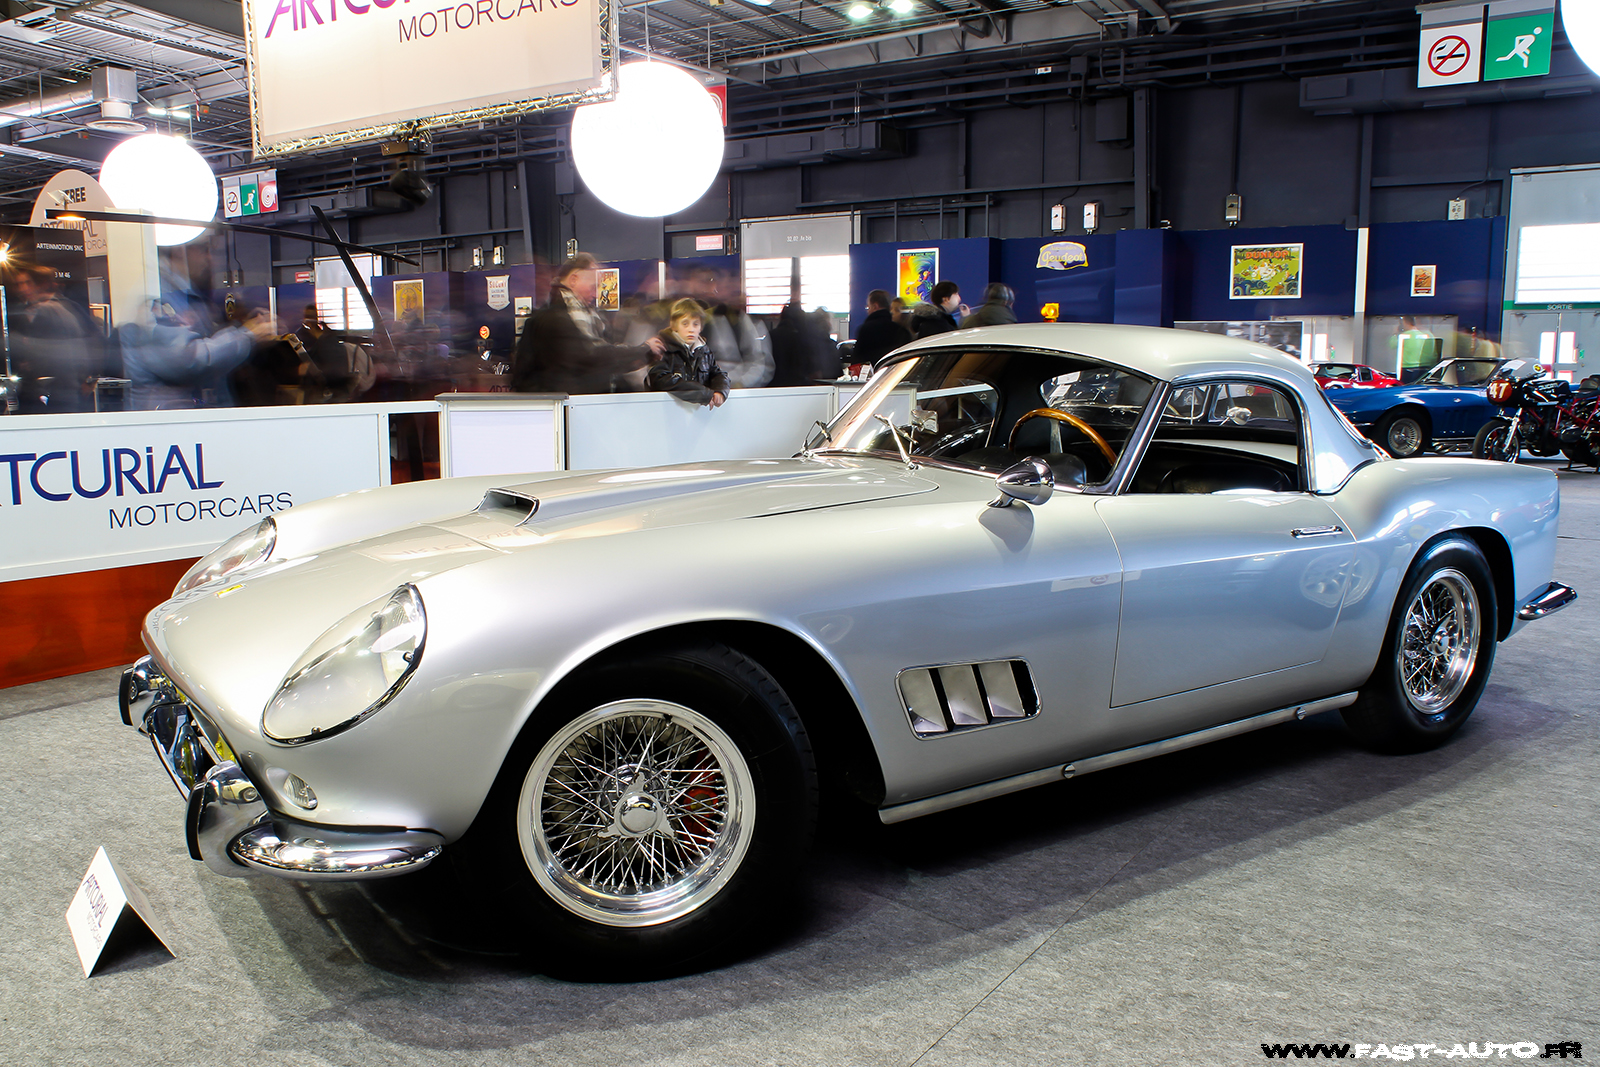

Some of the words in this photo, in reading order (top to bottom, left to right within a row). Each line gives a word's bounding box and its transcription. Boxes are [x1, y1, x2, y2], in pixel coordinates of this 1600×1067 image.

[399, 0, 579, 43] MOTORCA
[1245, 250, 1289, 259] DUNLOP
[1489, 383, 1509, 399] 47
[109, 491, 293, 529] MOTORCARS
